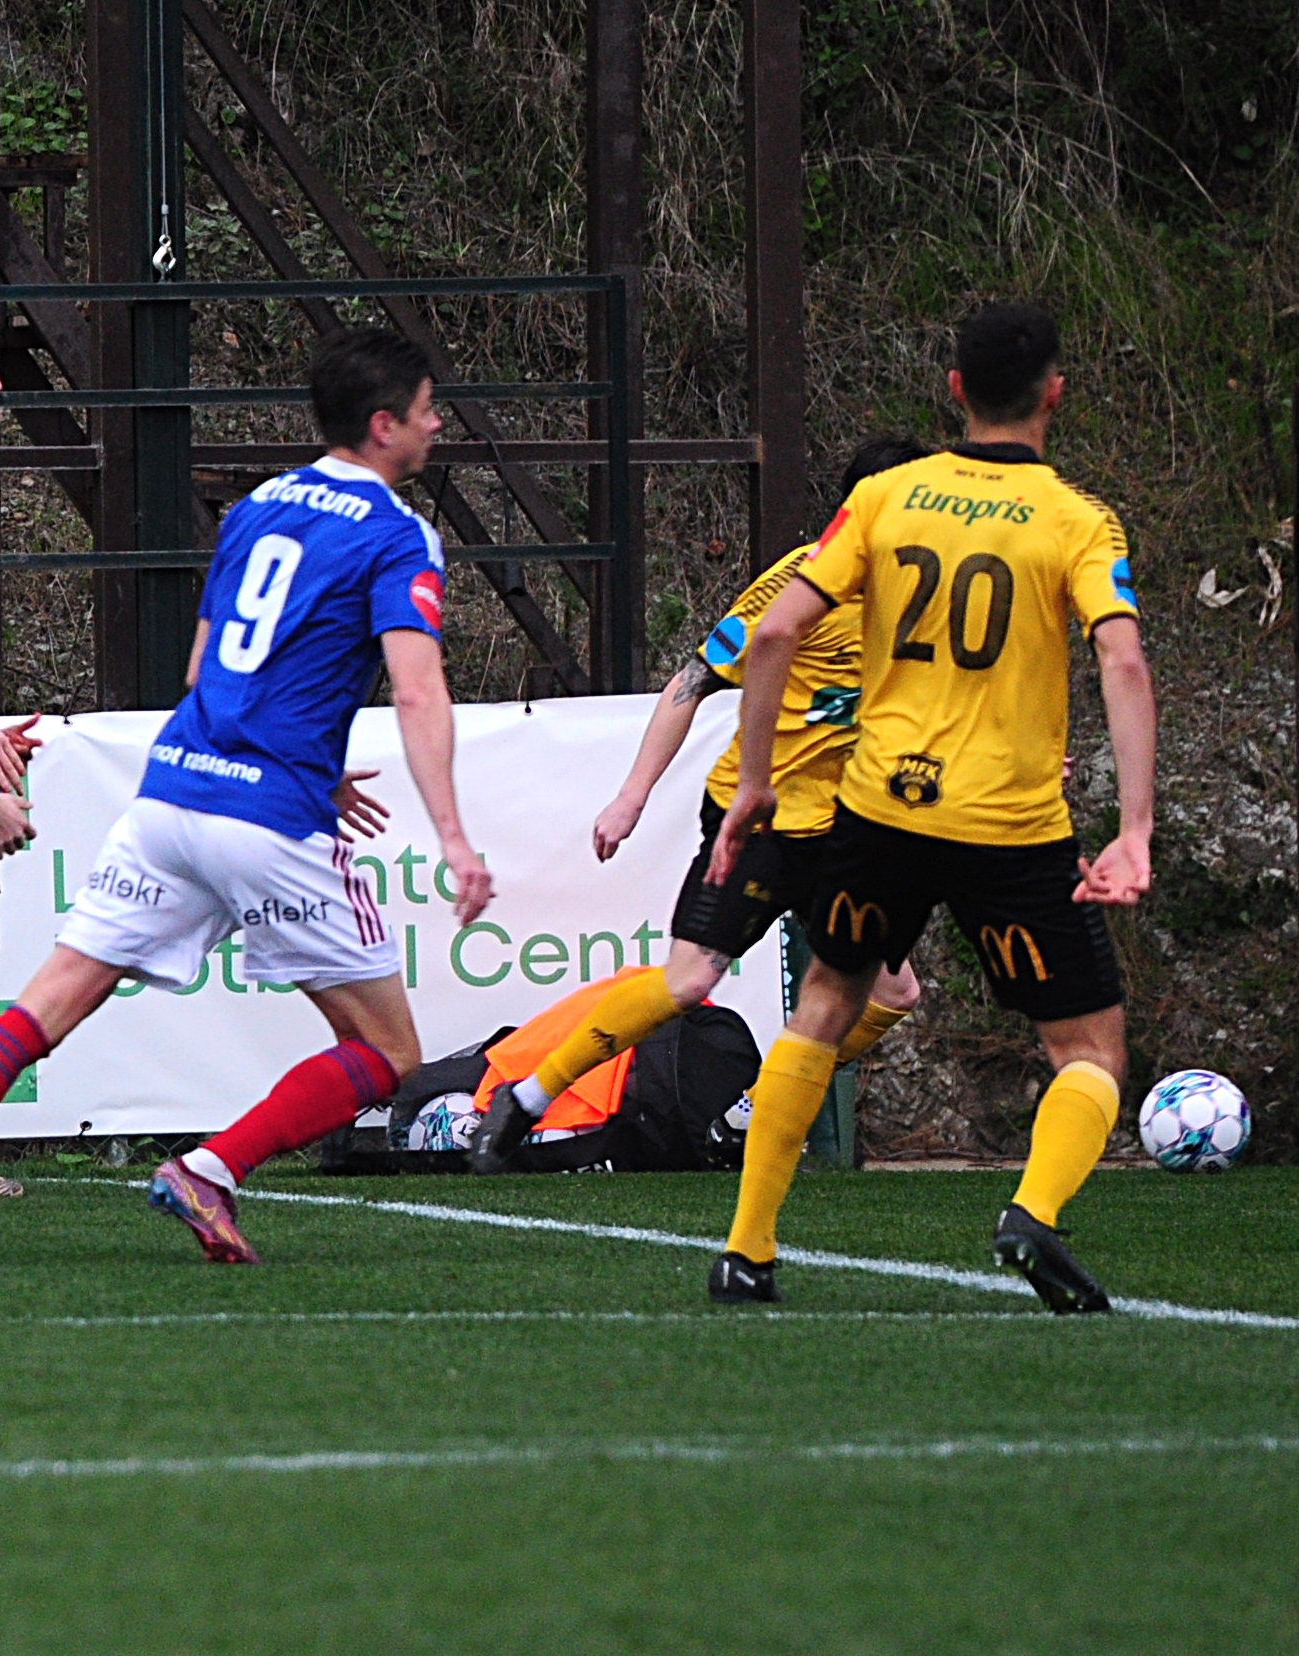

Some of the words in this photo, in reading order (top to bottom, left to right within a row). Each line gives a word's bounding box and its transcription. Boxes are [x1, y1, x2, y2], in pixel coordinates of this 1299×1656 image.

[903, 484, 1035, 526] Europris
[218, 533, 304, 674] 9
[892, 544, 1015, 671] 20
[899, 758, 940, 780] MFK
